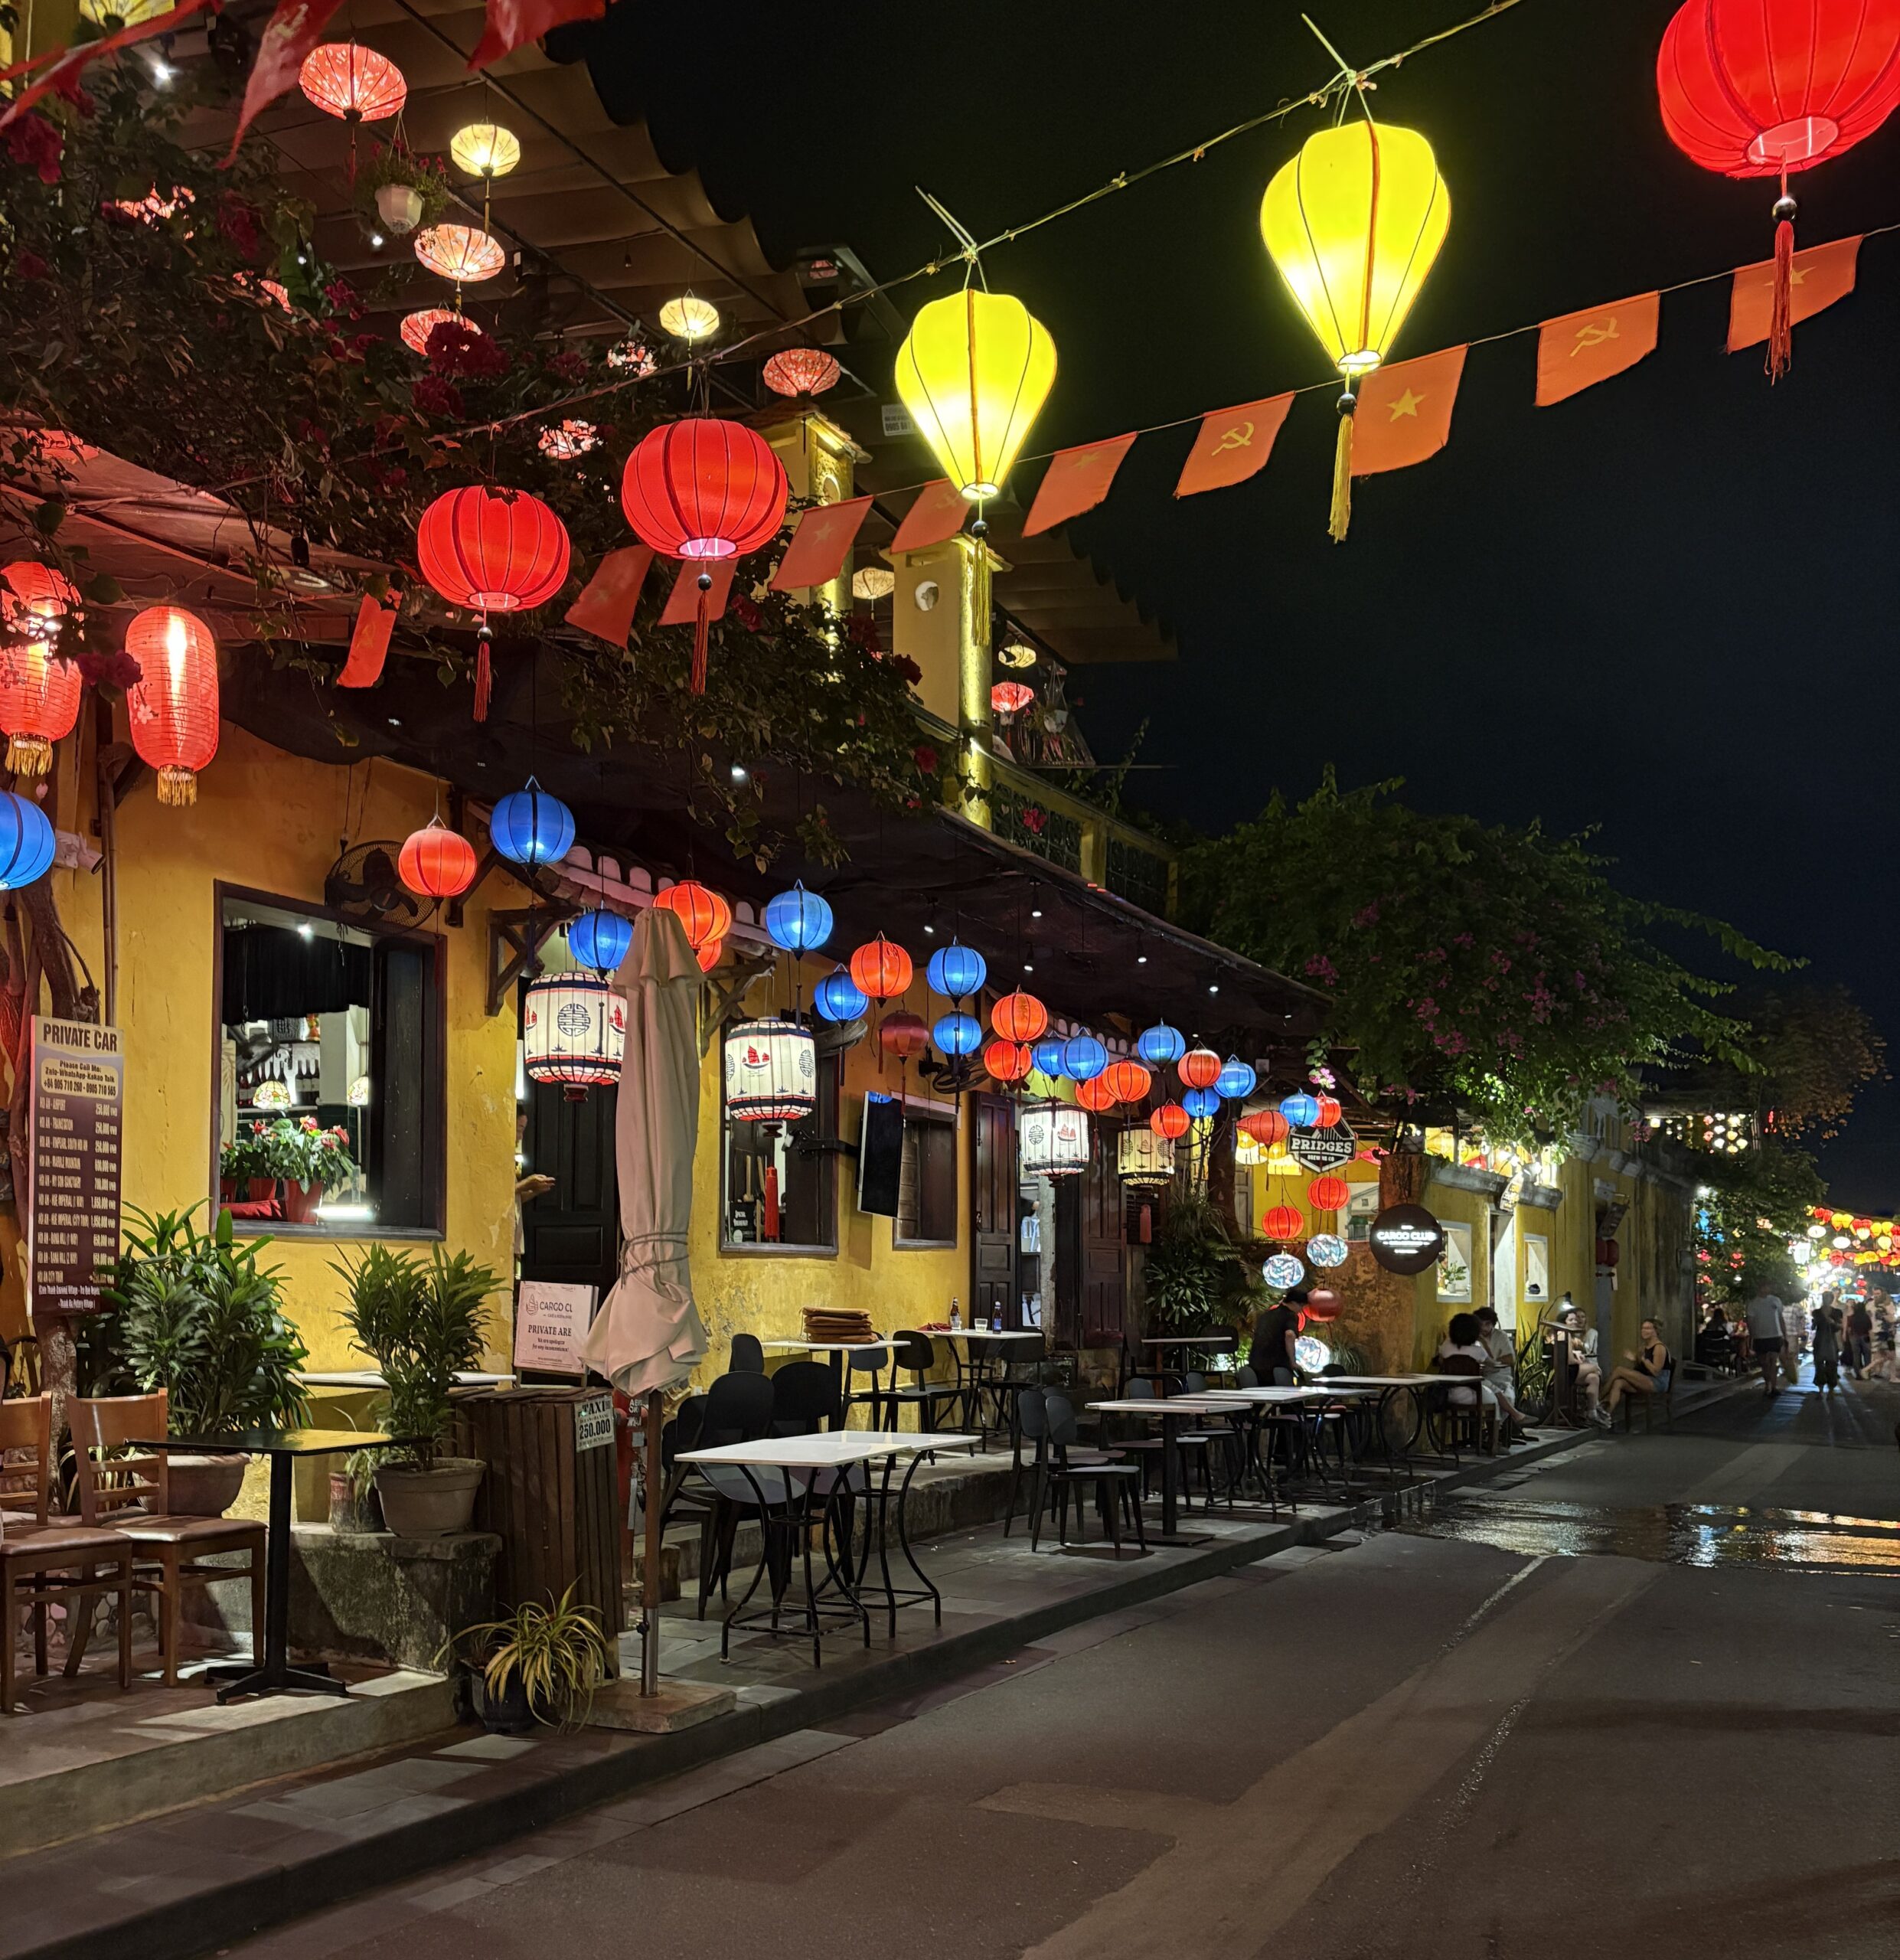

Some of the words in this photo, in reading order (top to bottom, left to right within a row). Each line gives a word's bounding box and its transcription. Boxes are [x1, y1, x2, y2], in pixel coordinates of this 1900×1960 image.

[43, 1022, 90, 1049] PRIVATE
[93, 1030, 117, 1052] CAR
[60, 1060, 78, 1070] Please
[105, 1074, 115, 1083] Talk
[44, 1078, 54, 1089] +84
[54, 1079, 63, 1090] 905
[64, 1080, 73, 1092] 710
[73, 1081, 83, 1093] 260
[86, 1083, 97, 1095] 0905
[98, 1084, 107, 1096] 710
[1291, 1138, 1352, 1154] BRIDGES
[540, 1302, 564, 1312] CARGO
[528, 1325, 557, 1336] PRIVATE
[557, 1328, 572, 1337] ARE
[582, 1400, 606, 1416] TAXI
[579, 1418, 611, 1439] 250.000
